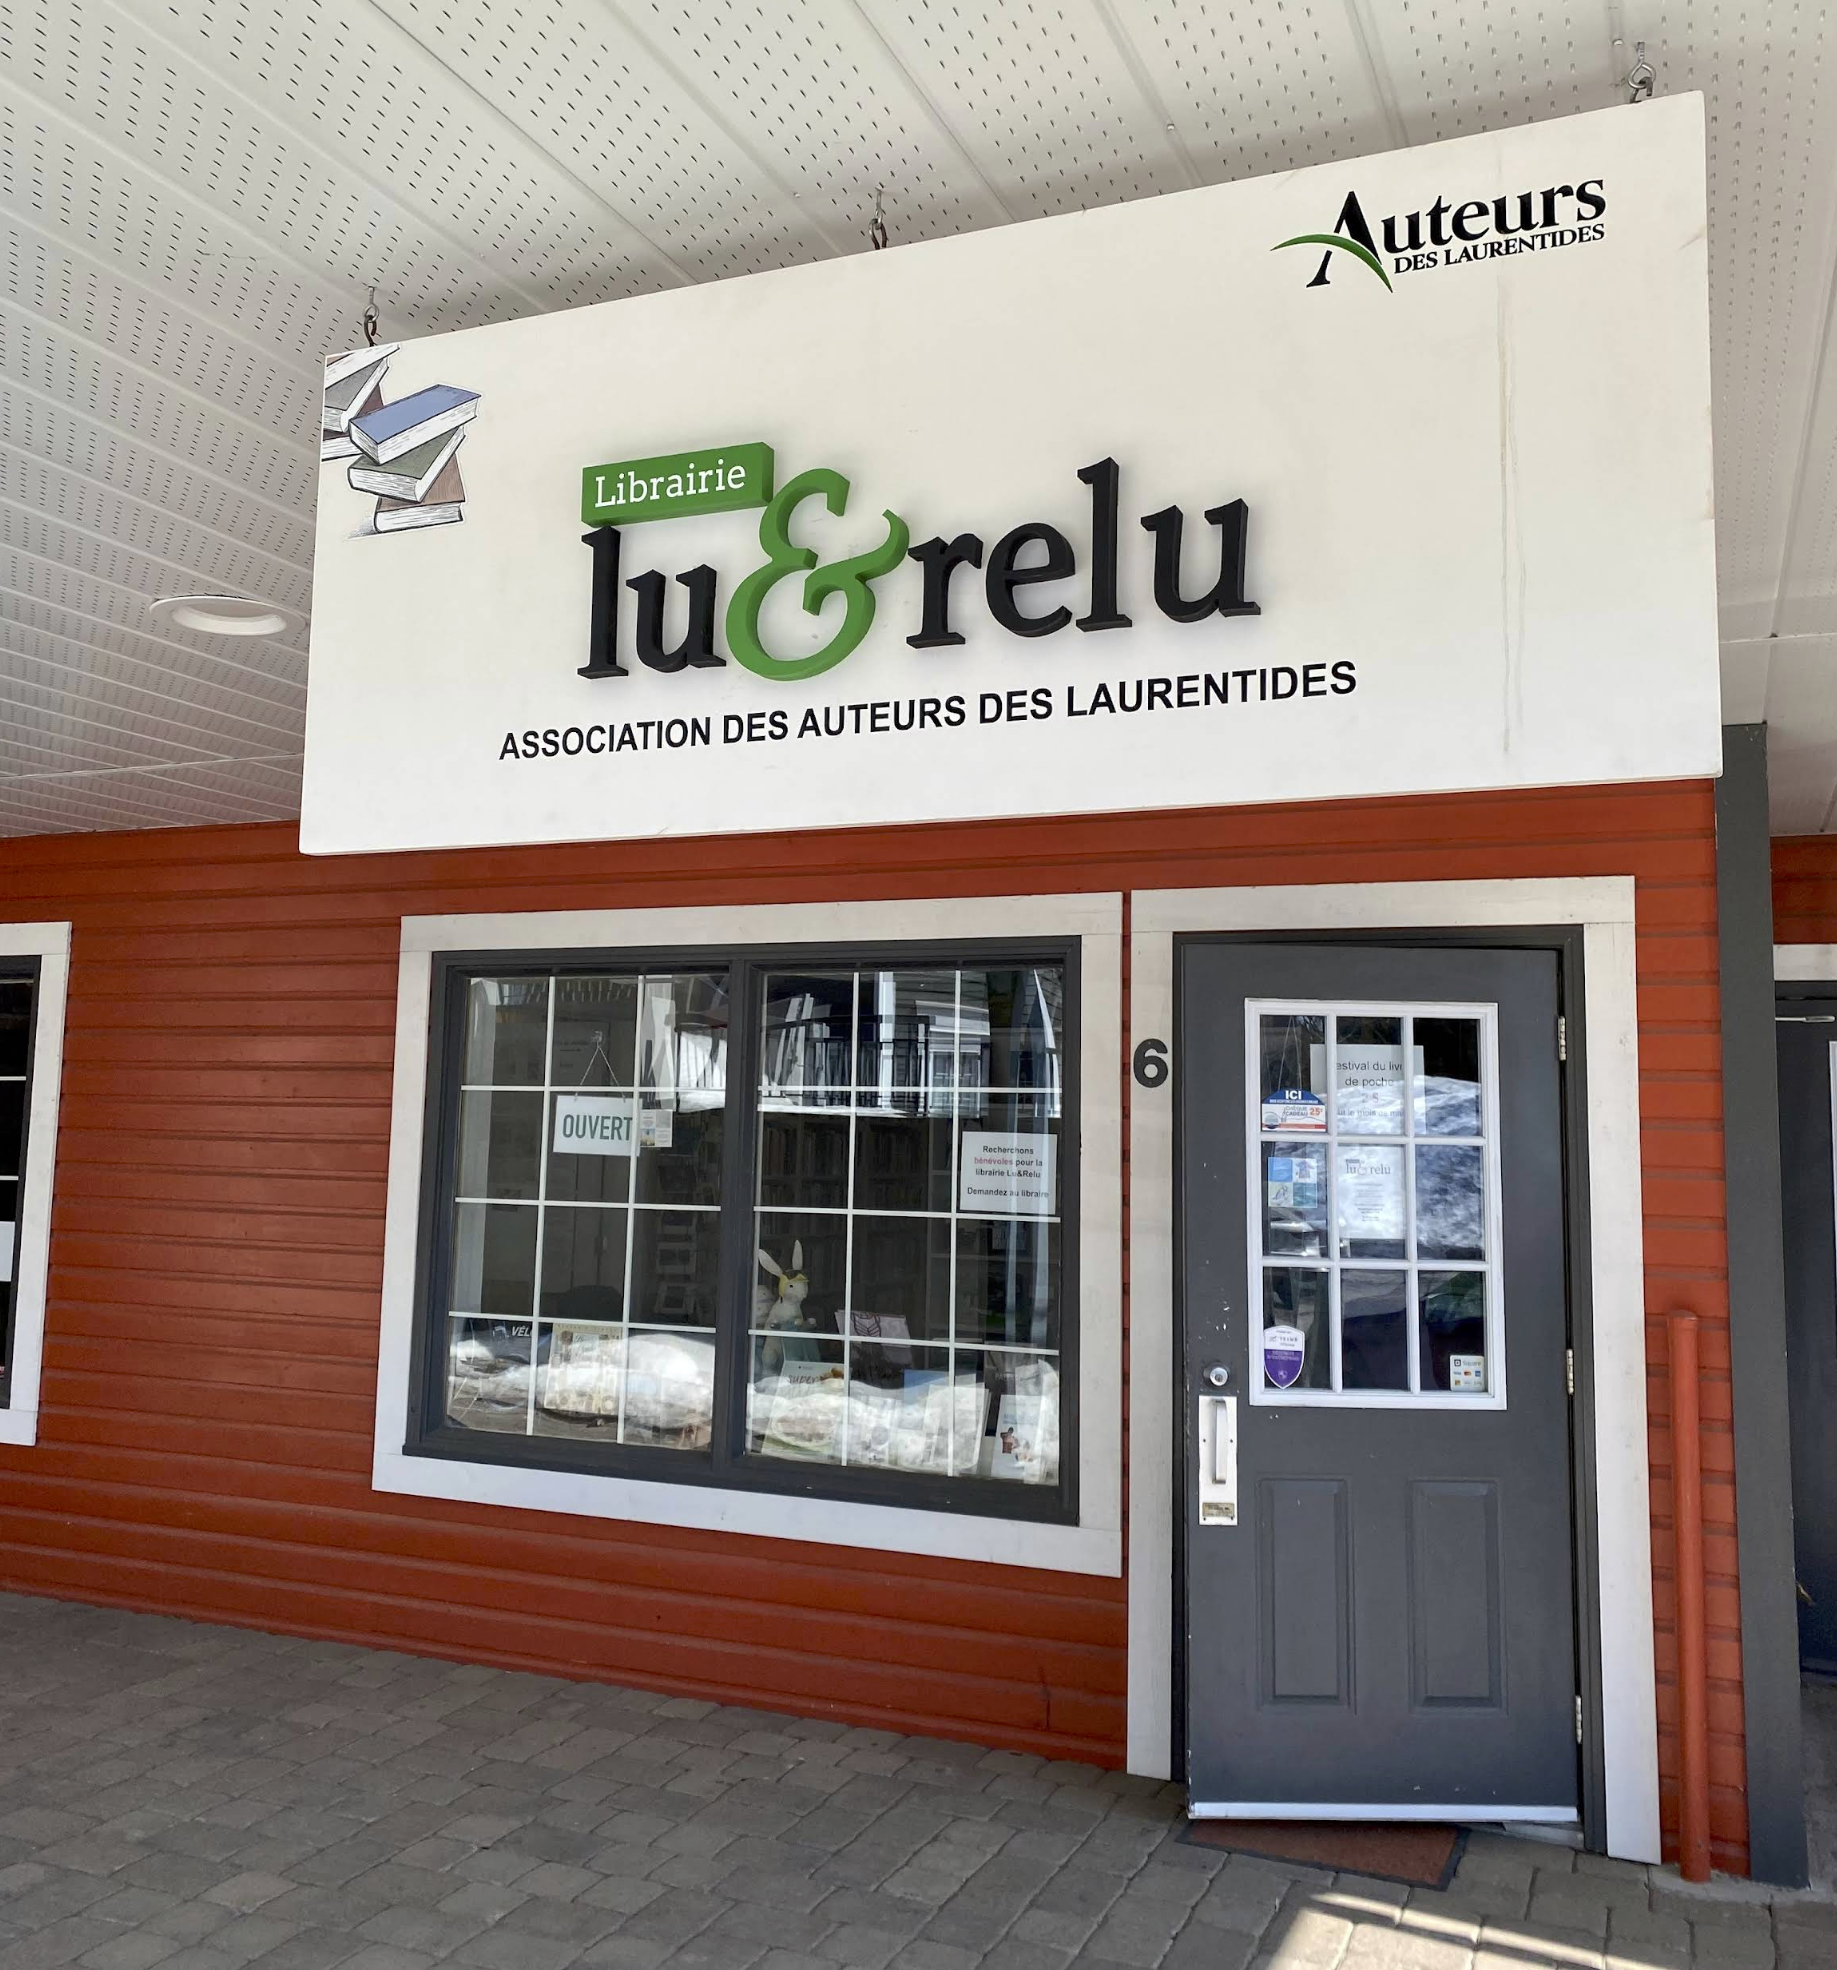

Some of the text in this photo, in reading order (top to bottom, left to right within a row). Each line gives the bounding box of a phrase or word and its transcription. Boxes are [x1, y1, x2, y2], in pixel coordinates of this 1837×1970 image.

[1306, 179, 1607, 288] Auteurs
[1394, 223, 1606, 274] DES LAURENTIDES
[594, 460, 748, 508] Librairie
[499, 660, 1358, 760] ASSOCIATION DES AUTEURS DES LAURENTIDES
[1133, 1038, 1169, 1088] 6
[1372, 1061, 1386, 1071] du
[1345, 1077, 1359, 1087] de
[1285, 1090, 1302, 1100] ICI
[562, 1114, 633, 1141] OUVERT
[982, 1145, 1034, 1154] Recherchons
[974, 1156, 1013, 1165] bénévoles
[1015, 1159, 1033, 1167] pour
[975, 1169, 1005, 1177] librairie
[967, 1187, 1008, 1196] Demandez
[511, 1326, 532, 1337] VÉL
